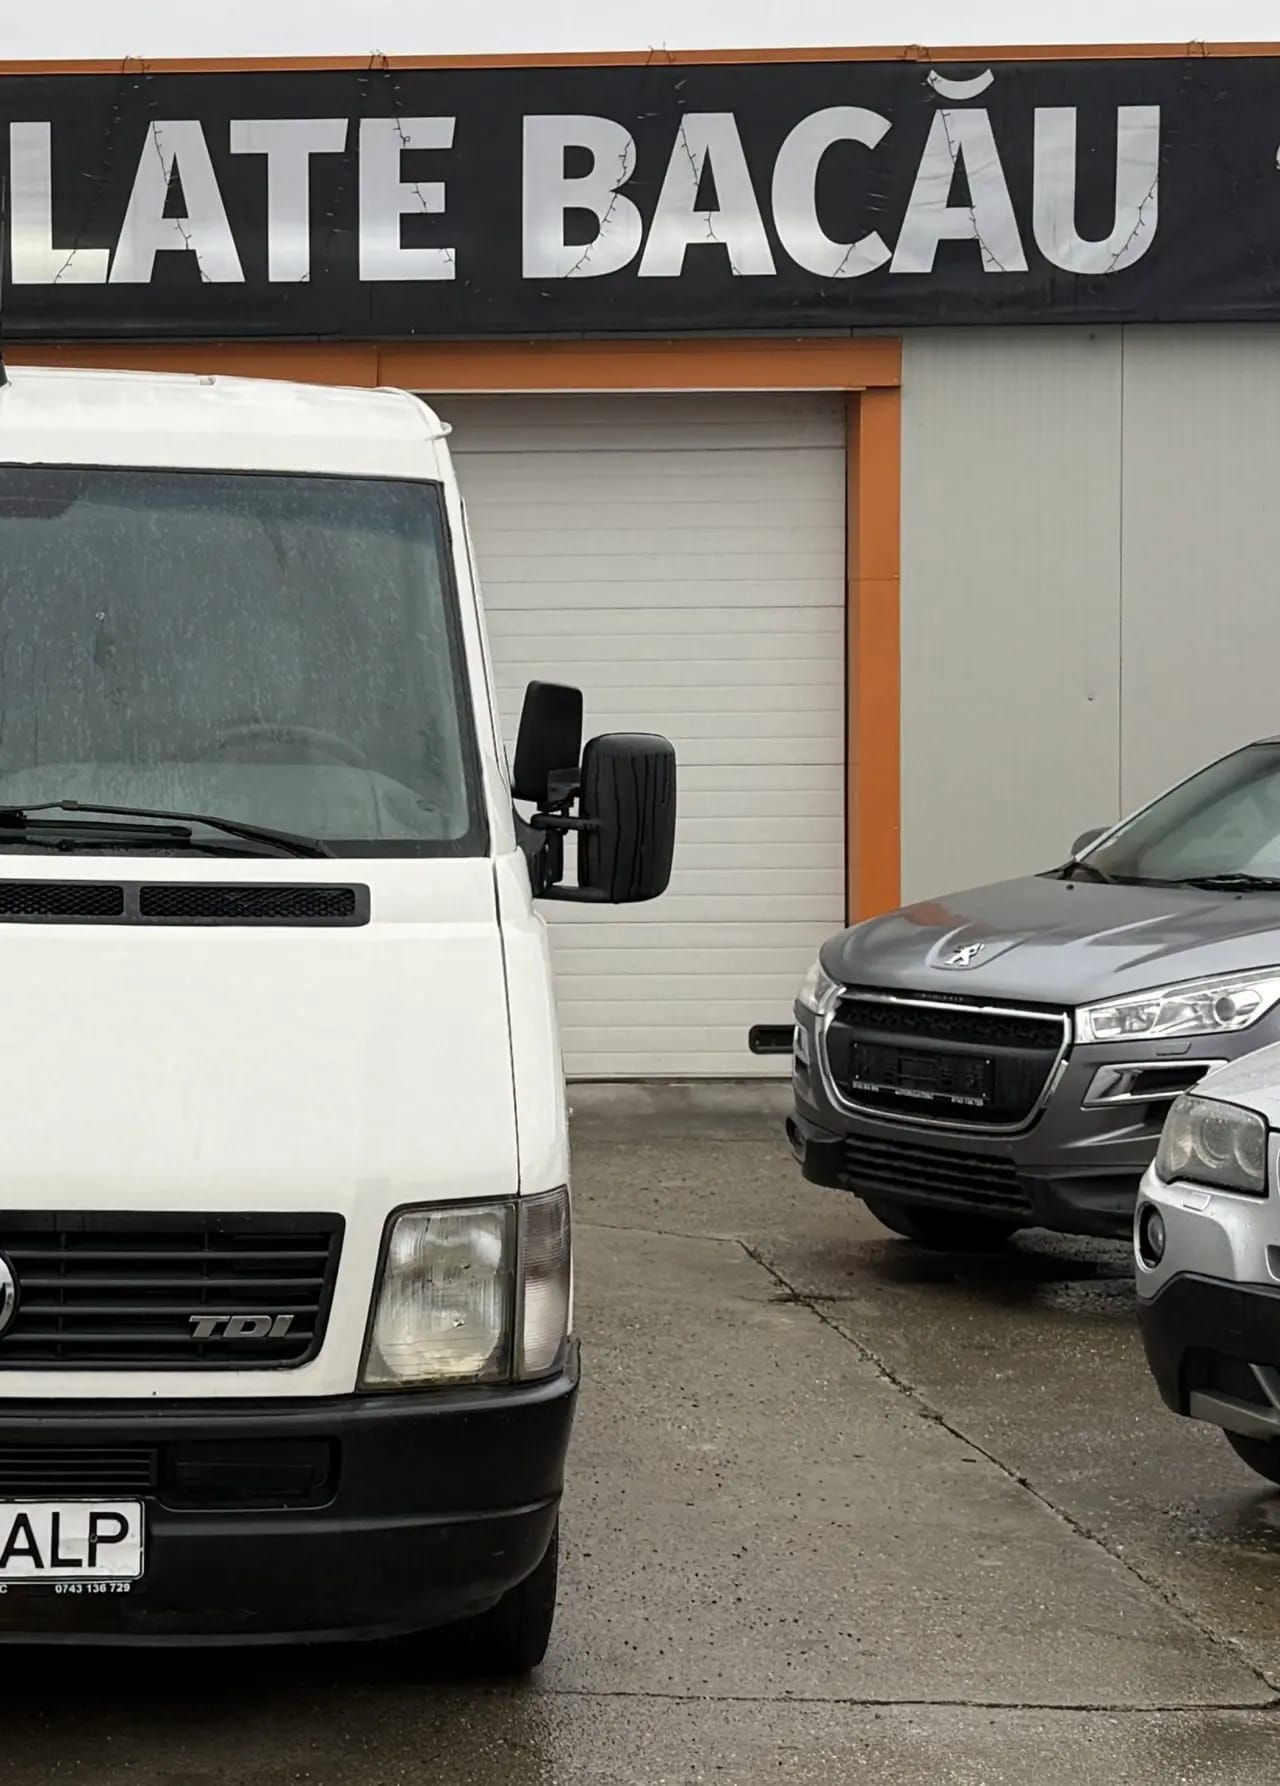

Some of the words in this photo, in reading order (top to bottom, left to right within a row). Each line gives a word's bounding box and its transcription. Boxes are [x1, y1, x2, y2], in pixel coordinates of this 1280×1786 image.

[521, 68, 1161, 280] BACĂU
[188, 1314, 295, 1339] TDI
[54, 1583, 83, 1594] 0743
[86, 1583, 107, 1593] 136
[109, 1582, 131, 1593] 729
